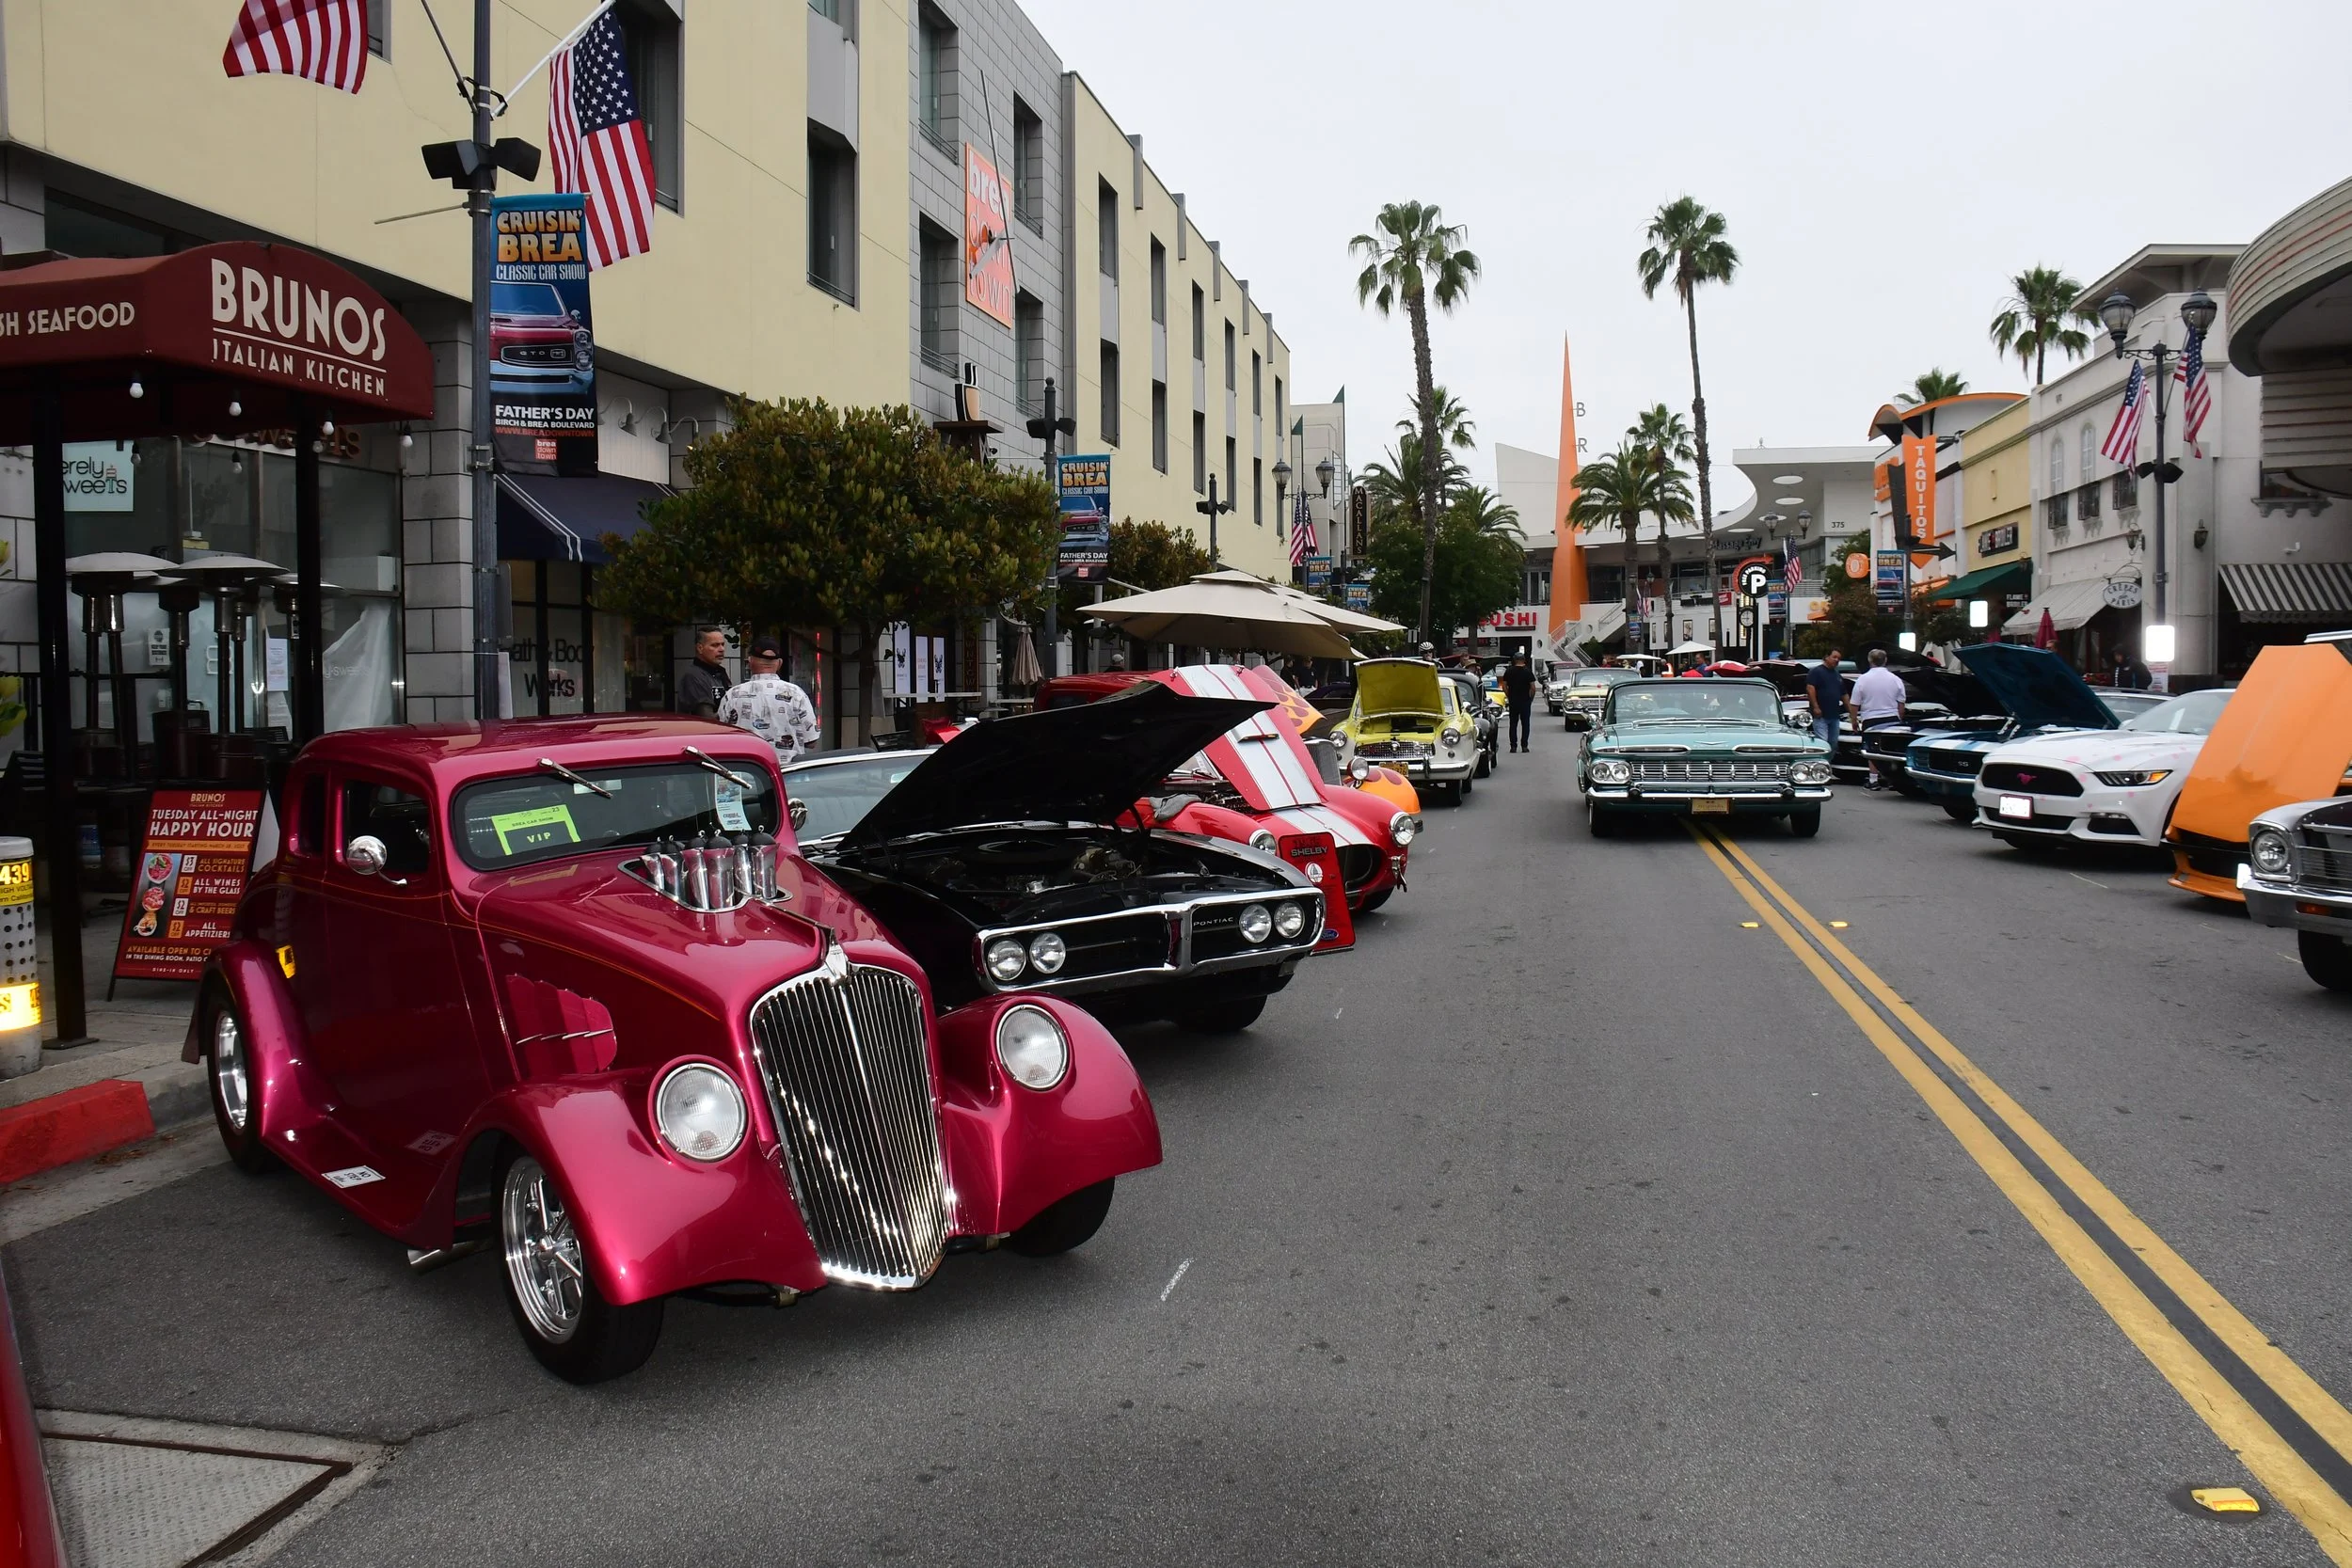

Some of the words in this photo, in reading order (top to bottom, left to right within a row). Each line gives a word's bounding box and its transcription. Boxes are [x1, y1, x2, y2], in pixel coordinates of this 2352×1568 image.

[969, 149, 1009, 222] brea
[497, 210, 582, 233] CRUISIN'
[498, 232, 583, 262] BREA
[496, 264, 536, 280] CLASSIC
[539, 264, 557, 280] CAR
[560, 264, 586, 280] SHOW
[212, 258, 385, 362] BRUNOS
[27, 302, 135, 336] SEAFOOD
[213, 339, 294, 375] ITALIAN
[307, 364, 385, 397] KITCHEN
[495, 404, 563, 420] FATHER'S
[565, 407, 595, 420] DAY
[495, 418, 519, 427] BIRCH
[528, 420, 549, 429] BREA
[62, 456, 106, 479] erely
[1061, 462, 1110, 473] CRUISIN'
[1062, 473, 1107, 486] BREA
[1915, 445, 1927, 539] TAQUITOS
[1355, 487, 1364, 554] MACALLANS
[1751, 574, 1767, 594] P
[2111, 597, 2135, 607] PARIS
[513, 638, 538, 662] ath
[524, 673, 575, 697] Wrks
[191, 793, 226, 802] BRUNOS
[152, 809, 198, 820] TUESDAY
[199, 810, 259, 820] ALL-NIGHT
[150, 821, 203, 836] HAPPY
[206, 822, 255, 837] HOUR
[527, 832, 551, 844] VIP
[1291, 846, 1327, 857] SHELBY
[198, 864, 246, 873] COCKTAILS
[194, 878, 210, 886] ALL
[214, 879, 241, 887] WINES
[201, 922, 216, 930] ALL
[1193, 916, 1234, 927] PONTIAC
[127, 945, 167, 954] AVAILABLE
[167, 946, 188, 955] OPEN
[358, 1170, 372, 1179] NO
